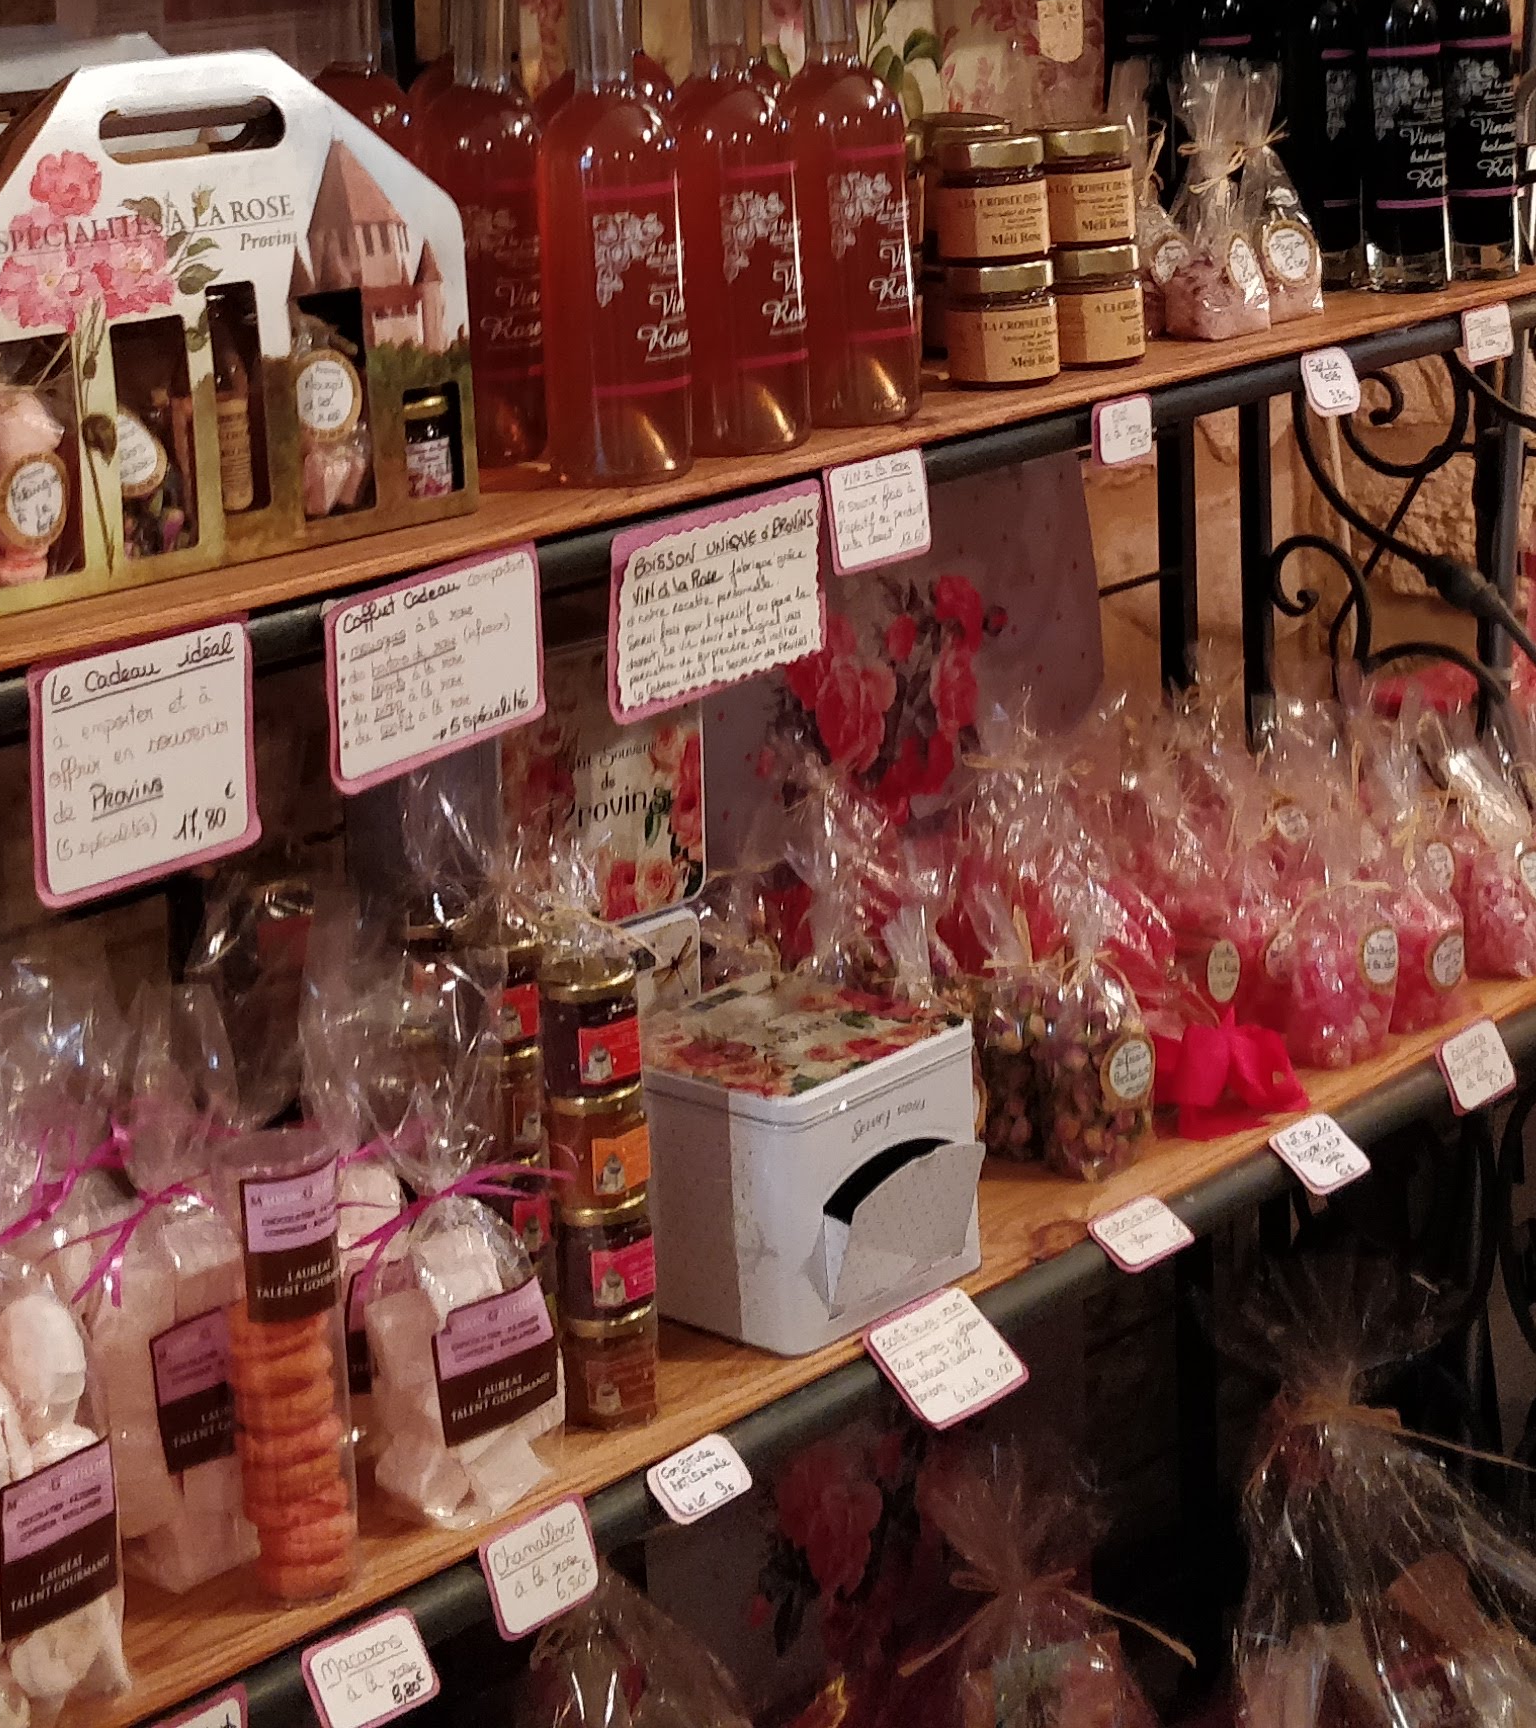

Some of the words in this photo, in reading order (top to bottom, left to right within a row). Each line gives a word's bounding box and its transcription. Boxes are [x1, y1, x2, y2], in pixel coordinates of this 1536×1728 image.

[229, 193, 295, 225] ROSE
[403, 582, 461, 610] Cadeau
[50, 675, 73, 706] Le
[85, 659, 162, 693] Cadeau
[177, 631, 235, 668] idéal
[81, 703, 154, 742] emporter
[168, 687, 188, 713] et
